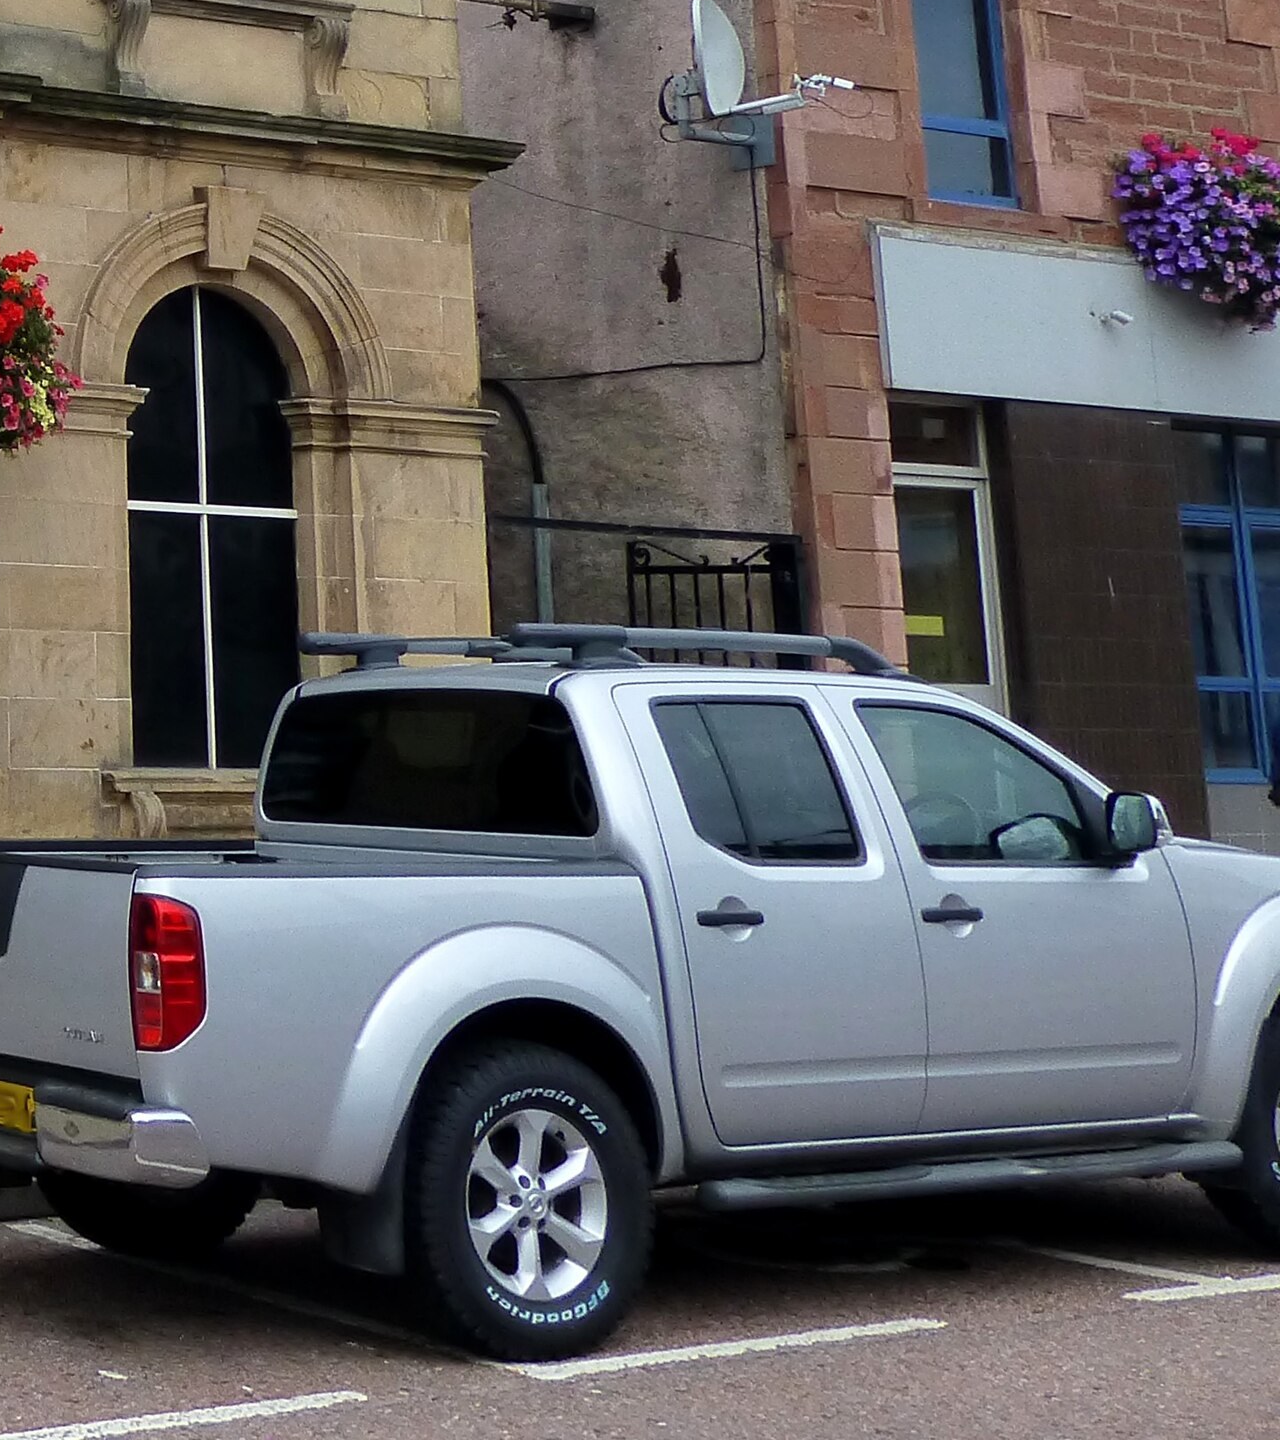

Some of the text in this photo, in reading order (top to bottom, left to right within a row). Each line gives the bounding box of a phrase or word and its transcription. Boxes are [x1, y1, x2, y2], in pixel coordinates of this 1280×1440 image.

[473, 1088, 607, 1138] All-Terrain T/A
[486, 1280, 610, 1324] BFGoodrich
